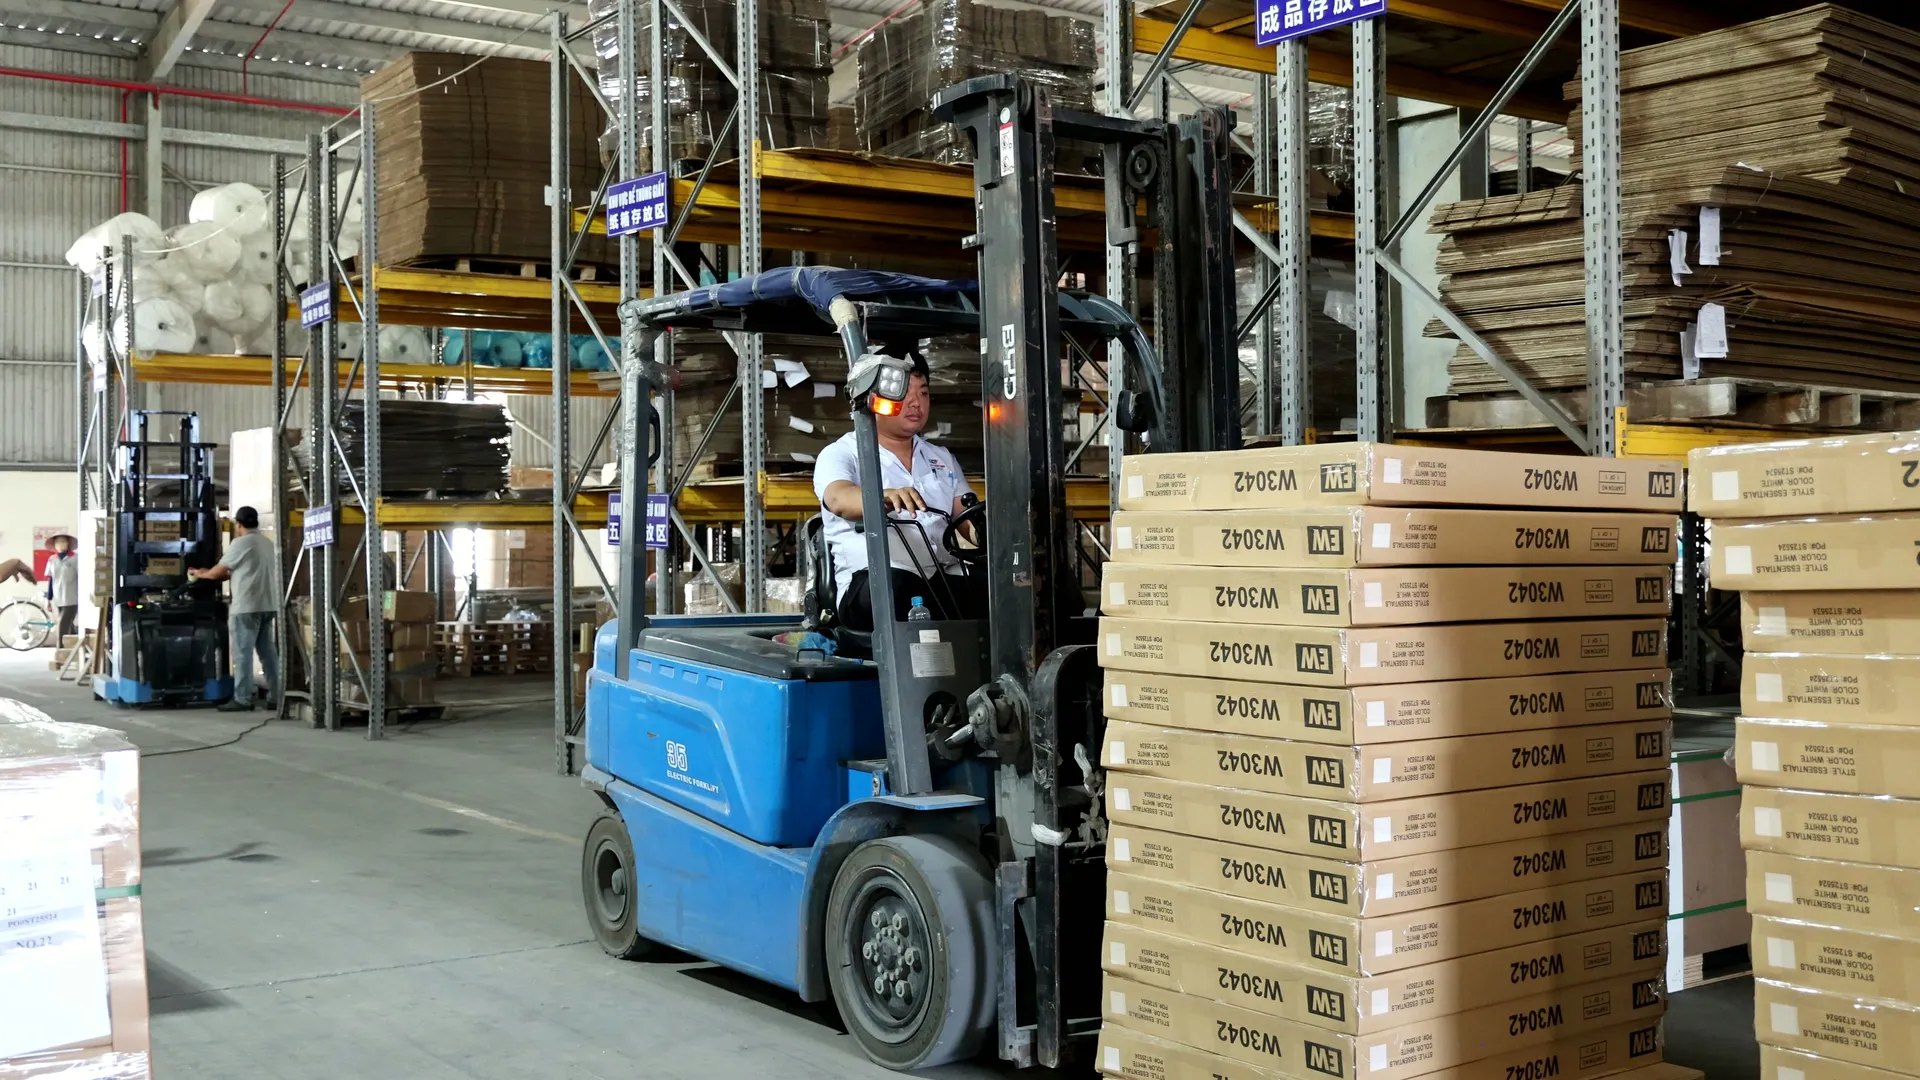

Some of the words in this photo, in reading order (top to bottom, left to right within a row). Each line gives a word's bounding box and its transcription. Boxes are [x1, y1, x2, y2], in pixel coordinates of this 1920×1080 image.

[1260, 0, 1380, 35] 成品存放
[609, 203, 664, 230] 纸箱存放区
[1002, 324, 1016, 400] BYD
[1234, 469, 1297, 493] W3042
[1325, 465, 1352, 487] EW
[1525, 469, 1578, 491] W3042
[1653, 475, 1672, 495] EW
[1221, 529, 1285, 550] W3042
[1312, 528, 1341, 552] EW
[1517, 528, 1570, 549] W3042
[1645, 530, 1666, 550] EW
[1778, 543, 1807, 551] ST25524
[1775, 554, 1798, 562] WHITE
[1799, 553, 1827, 561] COLOR:
[1756, 565, 1801, 573] ESSENTIALS
[1804, 564, 1828, 572] STYLE:
[1215, 586, 1279, 609] W3042
[1307, 587, 1336, 611] EW
[1509, 582, 1564, 603] W3042
[1640, 580, 1660, 600] EW
[1210, 641, 1273, 666] W3042
[1505, 637, 1560, 660] W3042
[1637, 633, 1658, 654] EW
[1300, 646, 1330, 671] EW
[1510, 691, 1565, 716] W3042
[1640, 684, 1661, 706] EW
[1216, 695, 1280, 721] W3042
[1308, 702, 1337, 727] EW
[1640, 733, 1660, 756] EW
[1805, 745, 1834, 754] ST25524
[1836, 747, 1853, 755] PO#:
[1217, 750, 1283, 777] W3042
[1513, 743, 1566, 769] W3042
[1801, 755, 1825, 764] WHITE
[1826, 757, 1854, 765] COLOR:
[666, 770, 692, 784] ELECTRIC
[1310, 758, 1341, 784] EW
[1782, 764, 1828, 775] ESSENTIALS
[1831, 768, 1856, 776] STYLE:
[1642, 784, 1662, 808] EW
[1220, 804, 1286, 835] W3042
[1514, 797, 1568, 824] W3042
[1808, 812, 1838, 822] ST25524
[1840, 815, 1857, 824] PO#:
[1313, 817, 1344, 844] EW
[1786, 831, 1832, 843] ESSENTIALS
[1805, 822, 1828, 832] WHITE
[1830, 825, 1858, 834] COLOR:
[1639, 833, 1659, 857] EW
[1834, 836, 1859, 845] STYLE:
[1221, 858, 1286, 889] W3042
[1514, 849, 1566, 877] W3042
[1314, 873, 1344, 900] EW
[1639, 882, 1659, 906] EW
[1815, 889, 1839, 899] WHITE
[1819, 879, 1849, 890] ST25524
[1850, 884, 1868, 893] PO#:
[1796, 897, 1842, 910] ESSENTIALS
[1840, 893, 1869, 903] COLOR:
[1514, 900, 1567, 930] W3042
[1845, 904, 1870, 914] STYLE:
[1221, 913, 1287, 948] W3042
[1314, 932, 1345, 961] EW
[1823, 946, 1853, 958] ST25524
[1855, 951, 1872, 961] PO#:
[1511, 953, 1564, 984] W3042
[1800, 963, 1846, 978] ESSENTIALS
[1819, 956, 1843, 966] WHITE
[1844, 960, 1873, 971] COLOR:
[1218, 967, 1283, 1003] W3042
[1849, 971, 1874, 982] STYLE:
[1312, 988, 1342, 1018] EW
[1509, 1004, 1564, 1036] W3042
[1822, 1023, 1846, 1034] WHITE
[1826, 1013, 1856, 1026] ST25524
[1858, 1019, 1875, 1029] PO#:
[1217, 1020, 1282, 1057] W3042
[1803, 1029, 1850, 1045] ESSENTIALS
[1848, 1028, 1876, 1040] COLOR:
[1852, 1039, 1877, 1051] STYLE:
[1310, 1044, 1339, 1074] EW
